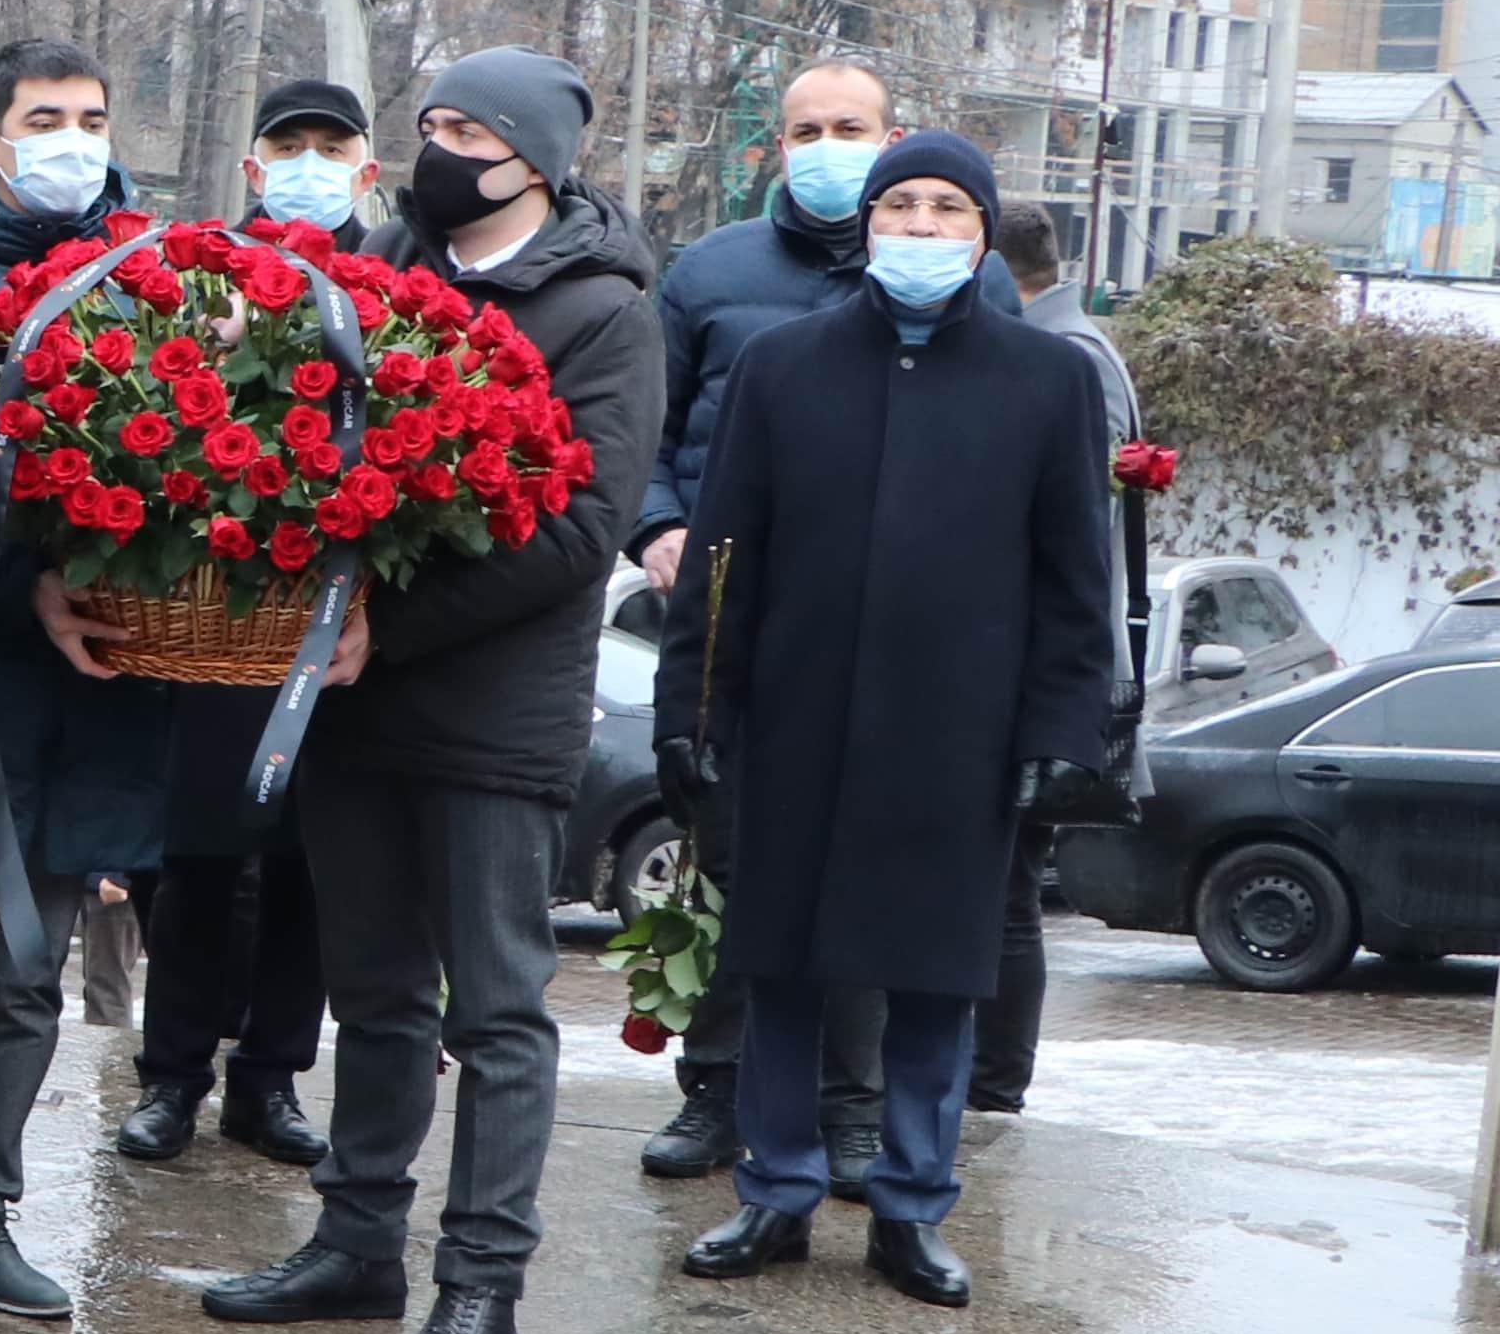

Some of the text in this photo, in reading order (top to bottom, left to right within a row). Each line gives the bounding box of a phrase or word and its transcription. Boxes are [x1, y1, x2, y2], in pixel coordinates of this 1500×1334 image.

[328, 293, 345, 331] SOCAR
[342, 390, 354, 429] SOCAR
[321, 587, 339, 625] SOCAR
[287, 674, 308, 710] SOCAR
[256, 764, 277, 803] SOCAR
